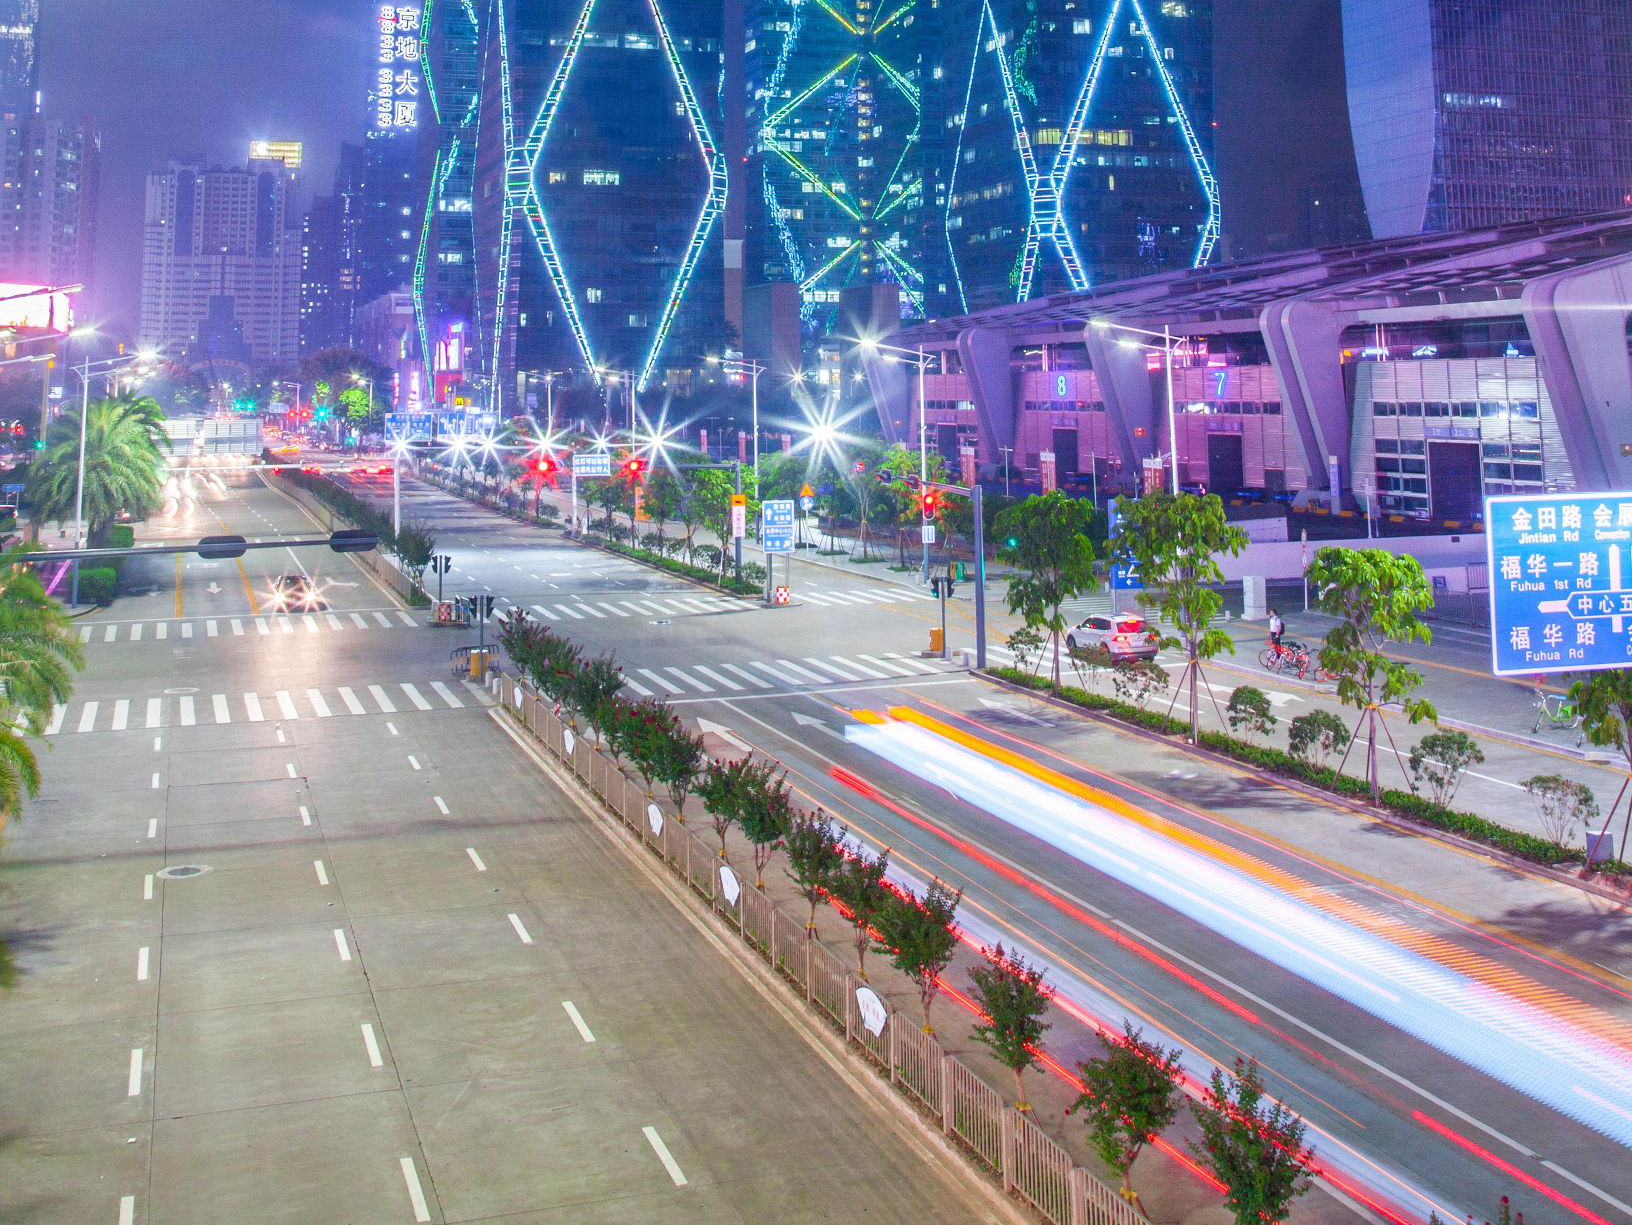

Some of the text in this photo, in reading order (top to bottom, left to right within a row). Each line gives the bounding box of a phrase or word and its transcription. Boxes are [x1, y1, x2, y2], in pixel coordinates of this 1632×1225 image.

[395, 7, 419, 126] 京地大厦
[1056, 374, 1068, 397] 8
[1213, 371, 1228, 397] 7
[1512, 505, 1582, 531] 金田路
[1518, 532, 1557, 544] Jintian
[1563, 530, 1580, 542] Rd
[1500, 551, 1600, 580] 福华一路
[1510, 578, 1593, 592] Fuhua 1st Rd
[1509, 621, 1597, 651] 福华路
[1525, 648, 1585, 663] Fuhua Rd
